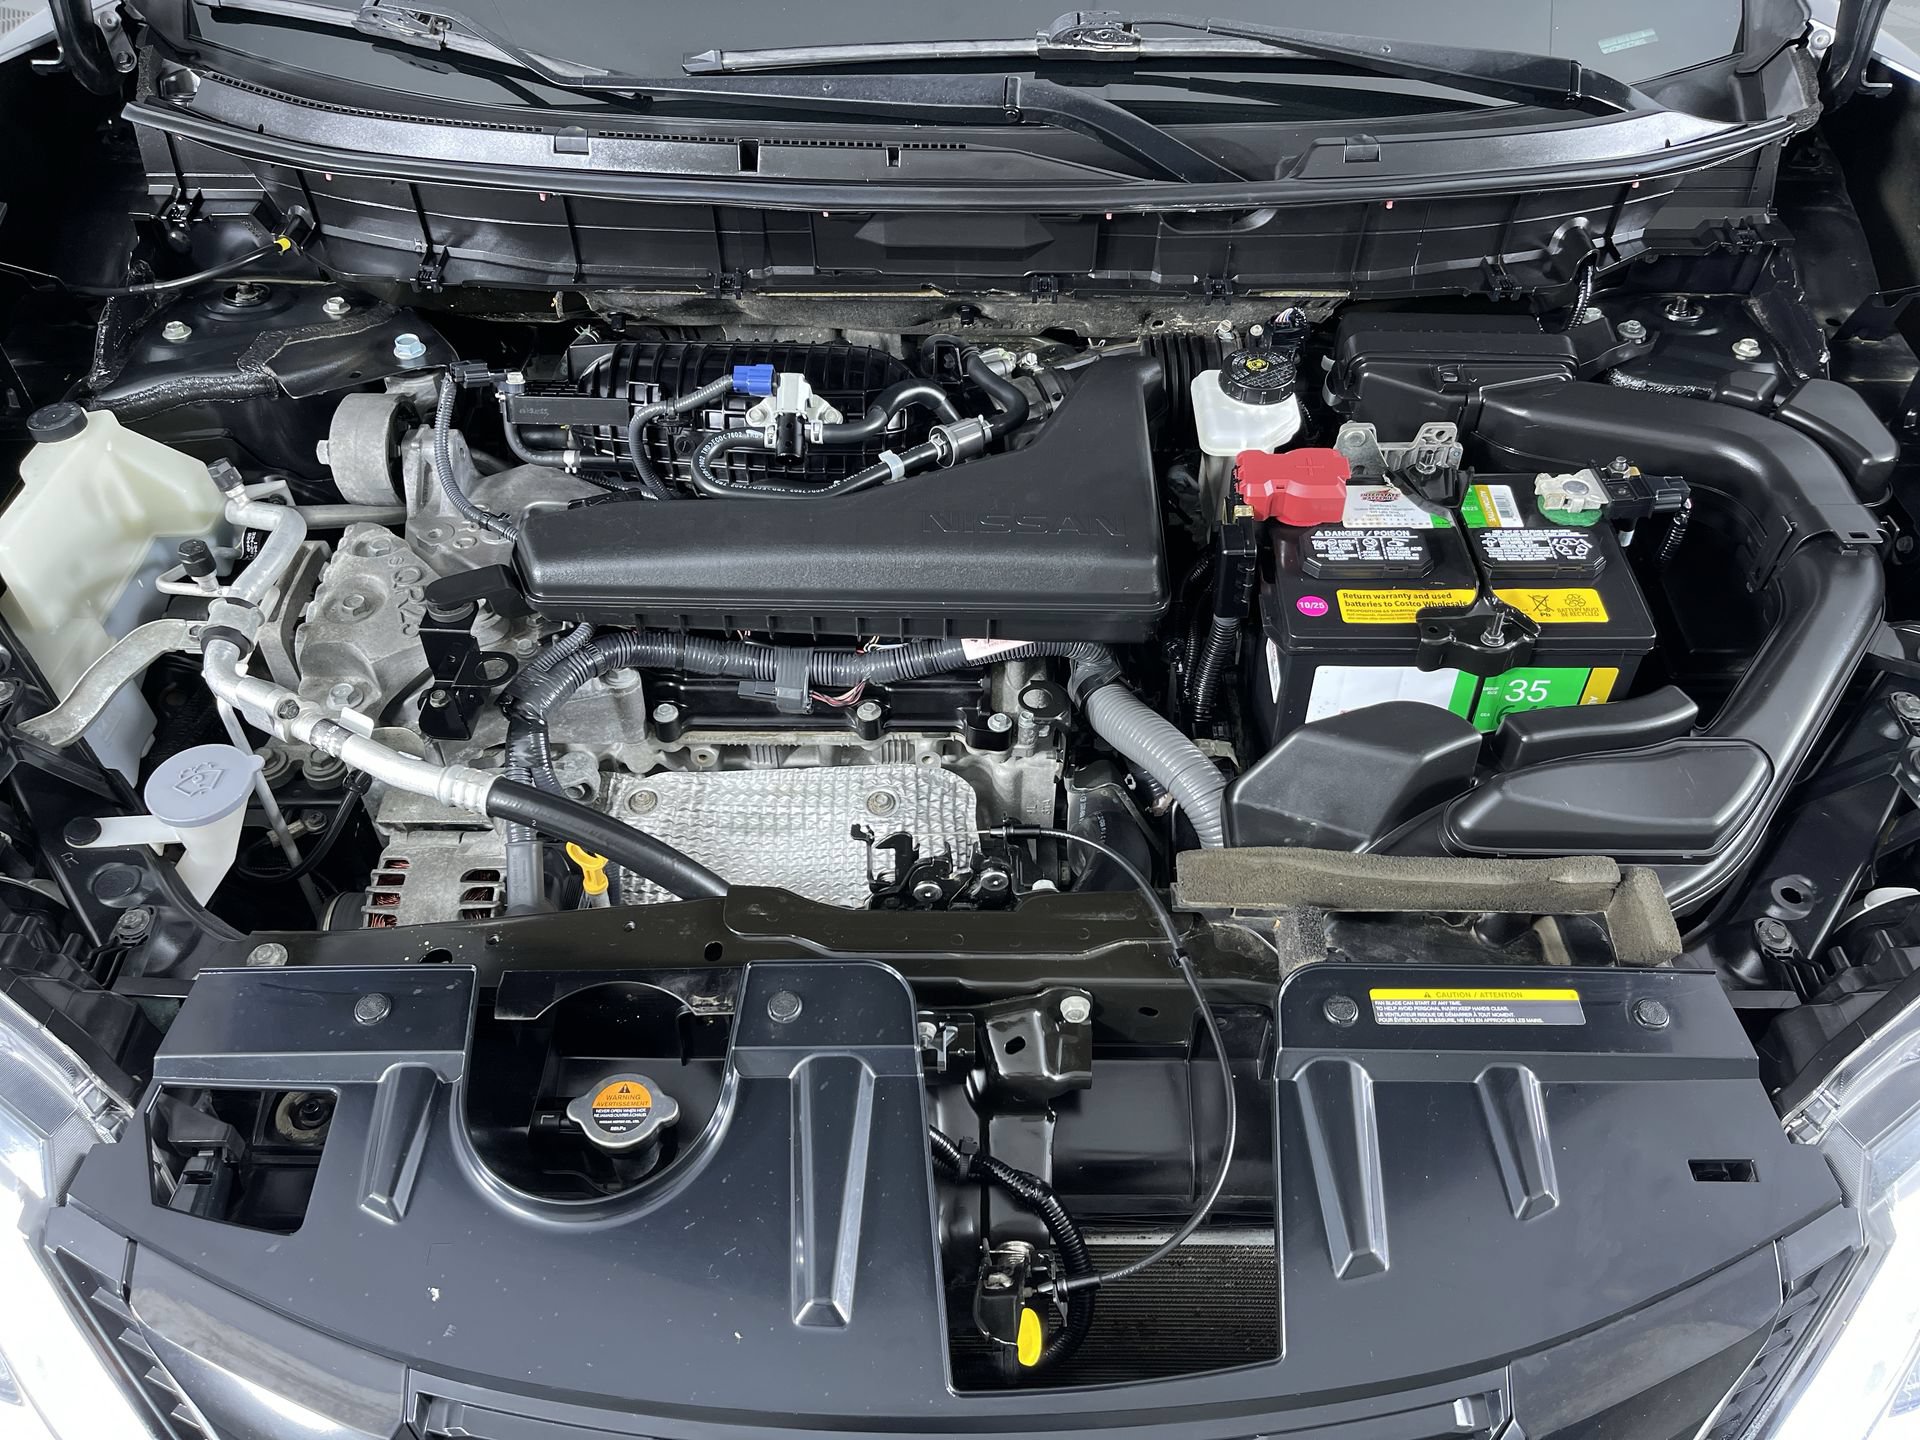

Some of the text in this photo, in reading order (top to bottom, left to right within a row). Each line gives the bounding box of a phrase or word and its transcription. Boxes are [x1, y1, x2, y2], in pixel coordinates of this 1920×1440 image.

[922, 511, 1126, 537] NISSAN
[1373, 592, 1411, 600] warranty
[1299, 601, 1325, 609] 10/25
[1504, 679, 1552, 703] 35
